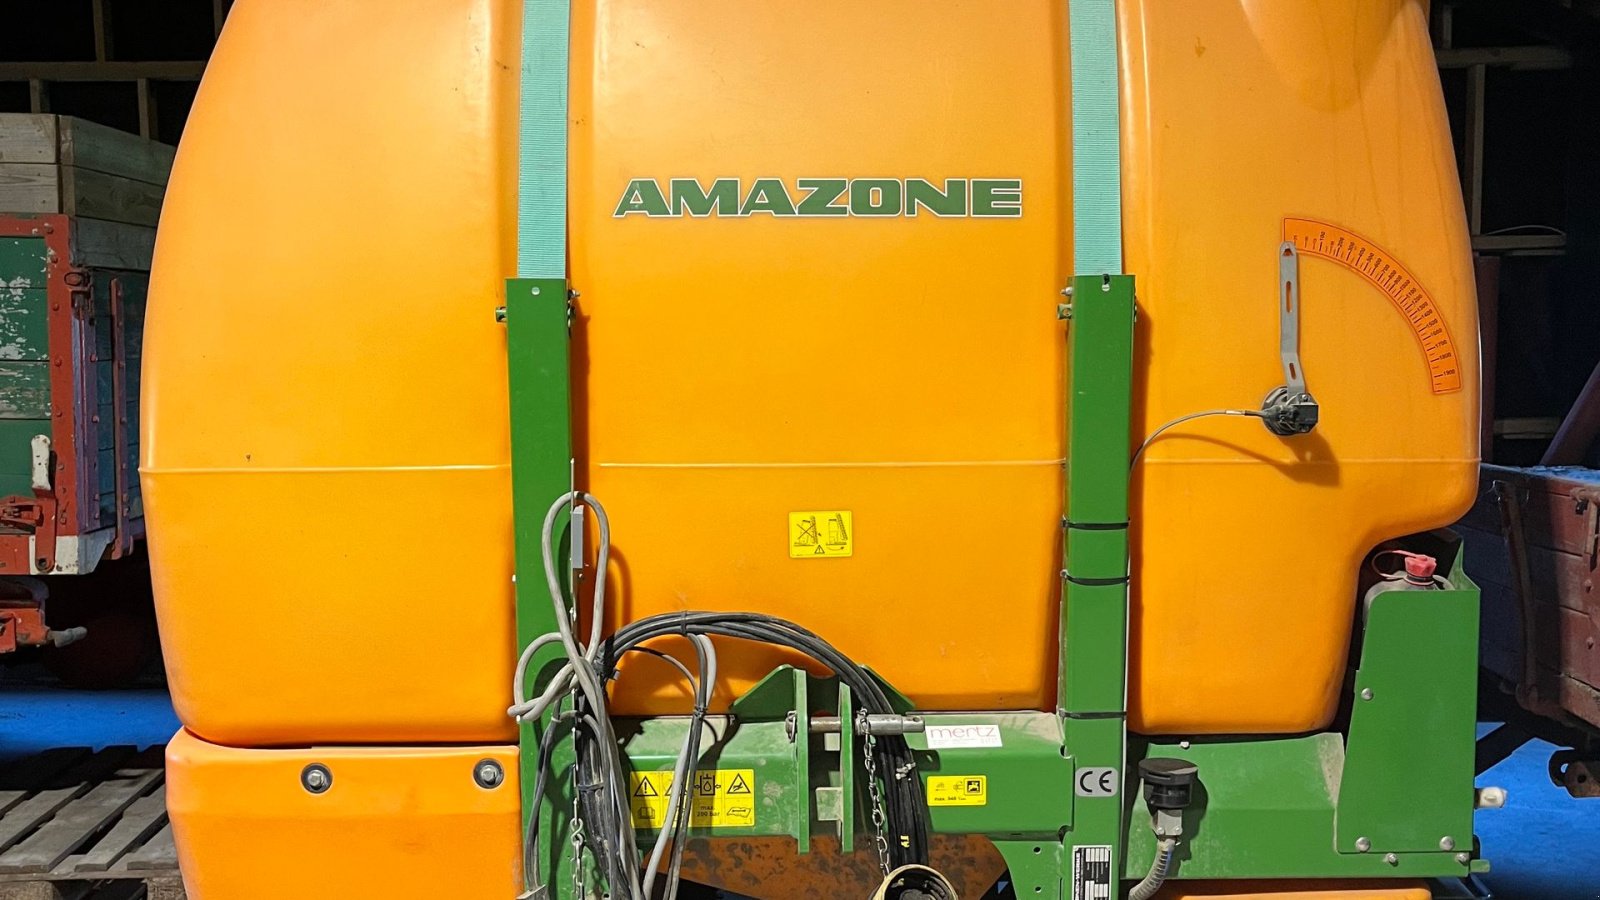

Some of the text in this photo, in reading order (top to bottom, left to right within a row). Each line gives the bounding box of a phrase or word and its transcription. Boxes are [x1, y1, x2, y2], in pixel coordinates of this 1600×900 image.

[613, 178, 1022, 217] AMAZONE
[930, 726, 997, 738] mertz
[1080, 770, 1112, 793] CE
